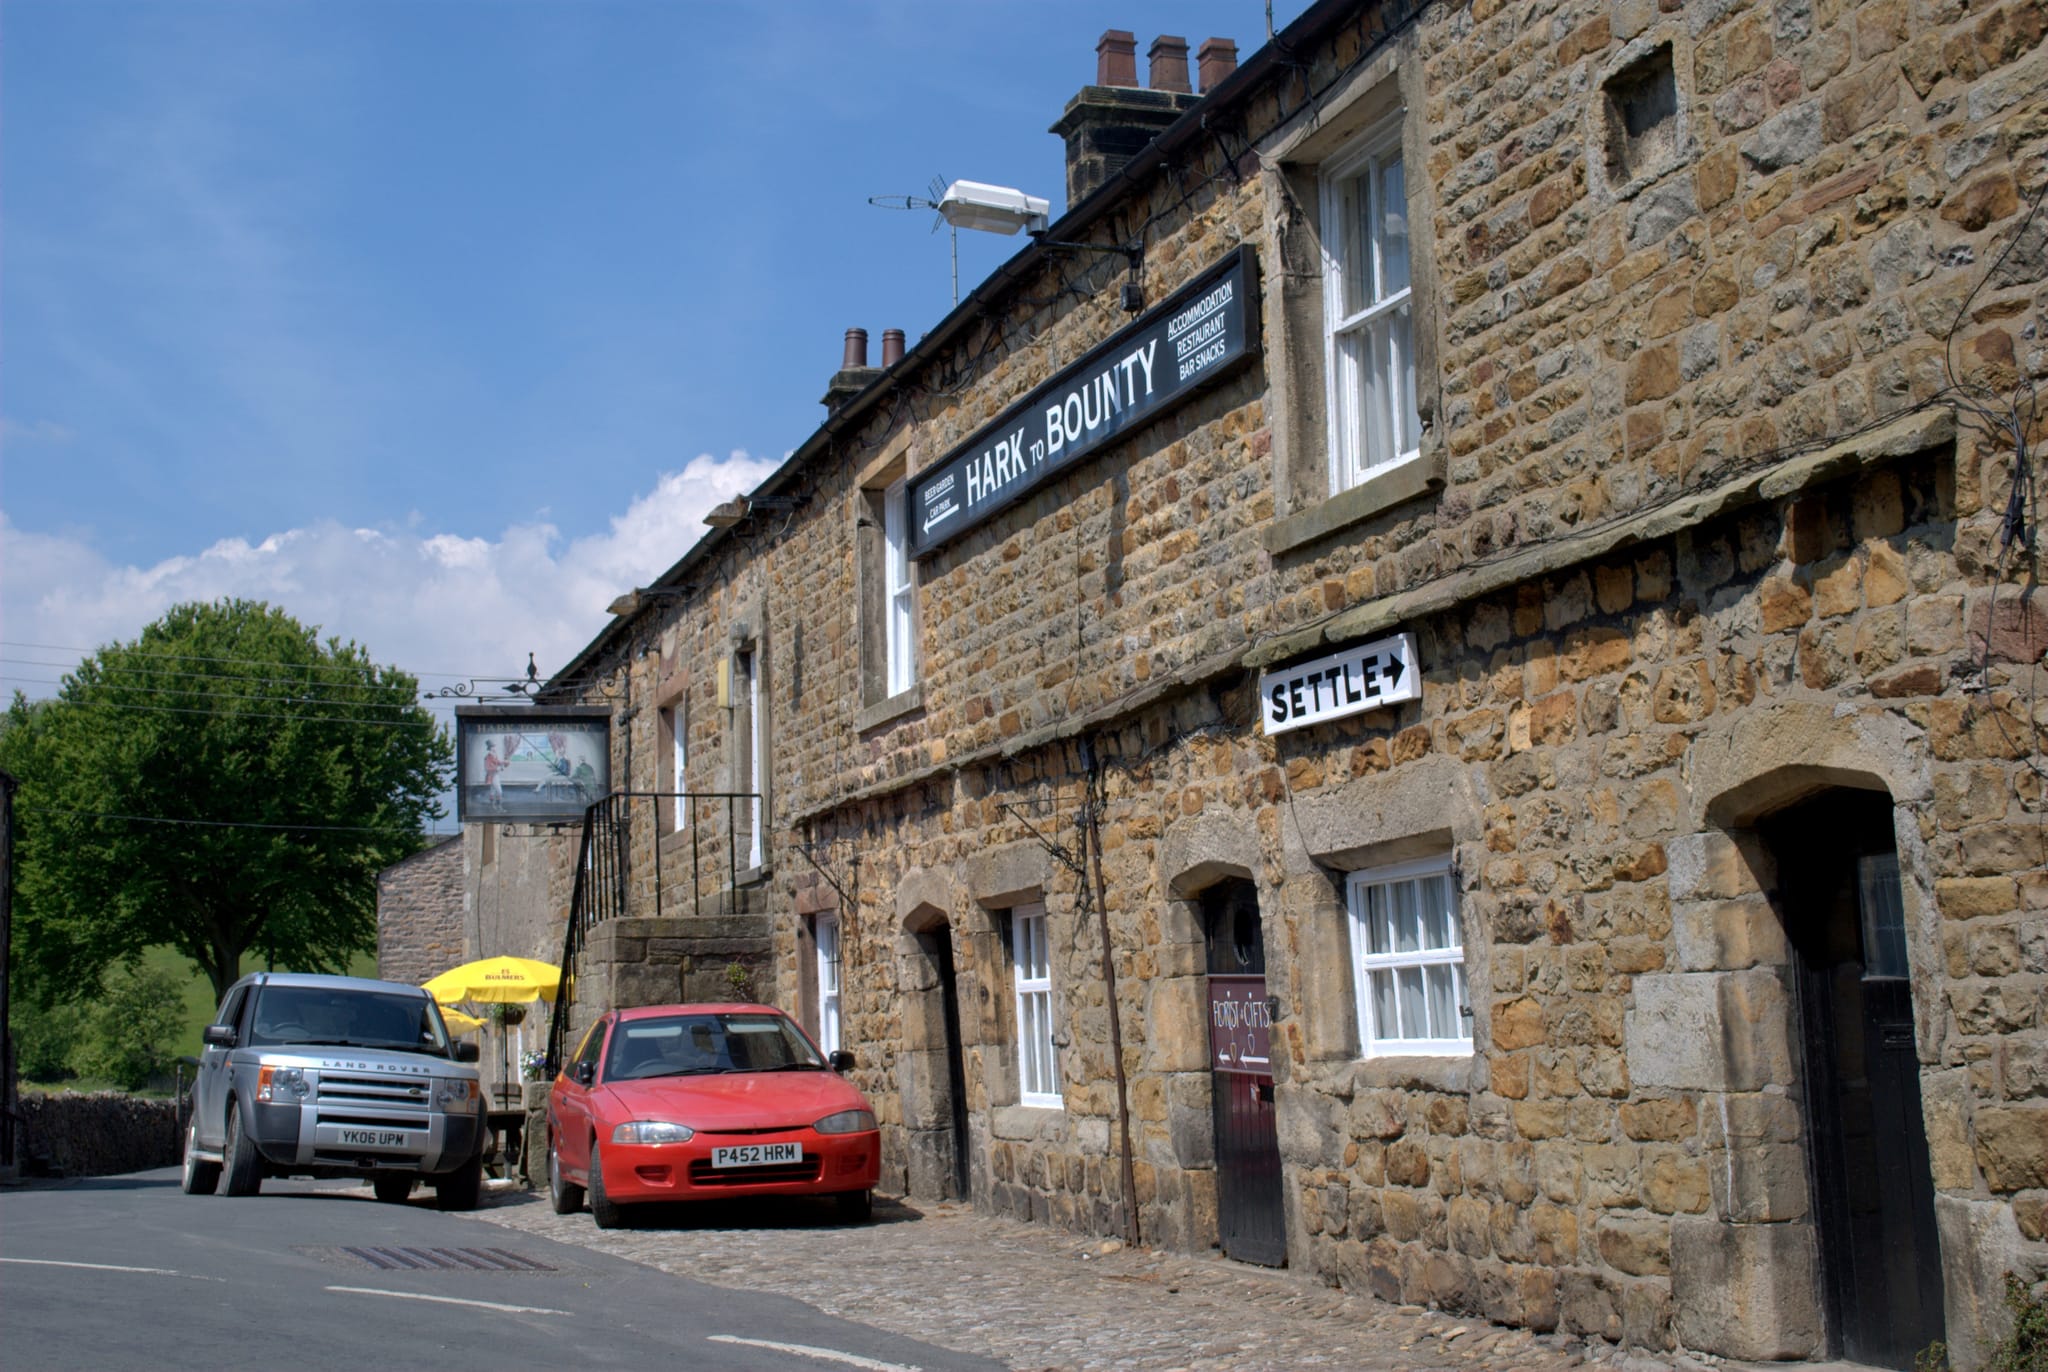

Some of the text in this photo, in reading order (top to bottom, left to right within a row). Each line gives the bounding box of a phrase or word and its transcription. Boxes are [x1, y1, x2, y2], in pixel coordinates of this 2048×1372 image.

[1168, 280, 1232, 337] ACCOMMODATION
[1177, 311, 1225, 357] RESTAURANT
[1179, 339, 1225, 381] BAR SNACKS
[965, 338, 1158, 508] HARK TO BOUNTY
[1271, 655, 1381, 723] SETTLE
[1243, 1001, 1271, 1028] GIFTS
[322, 1060, 431, 1073] LAND ROVER
[343, 1130, 405, 1146] YK06 UPM
[718, 1143, 795, 1164] P452 HRM
